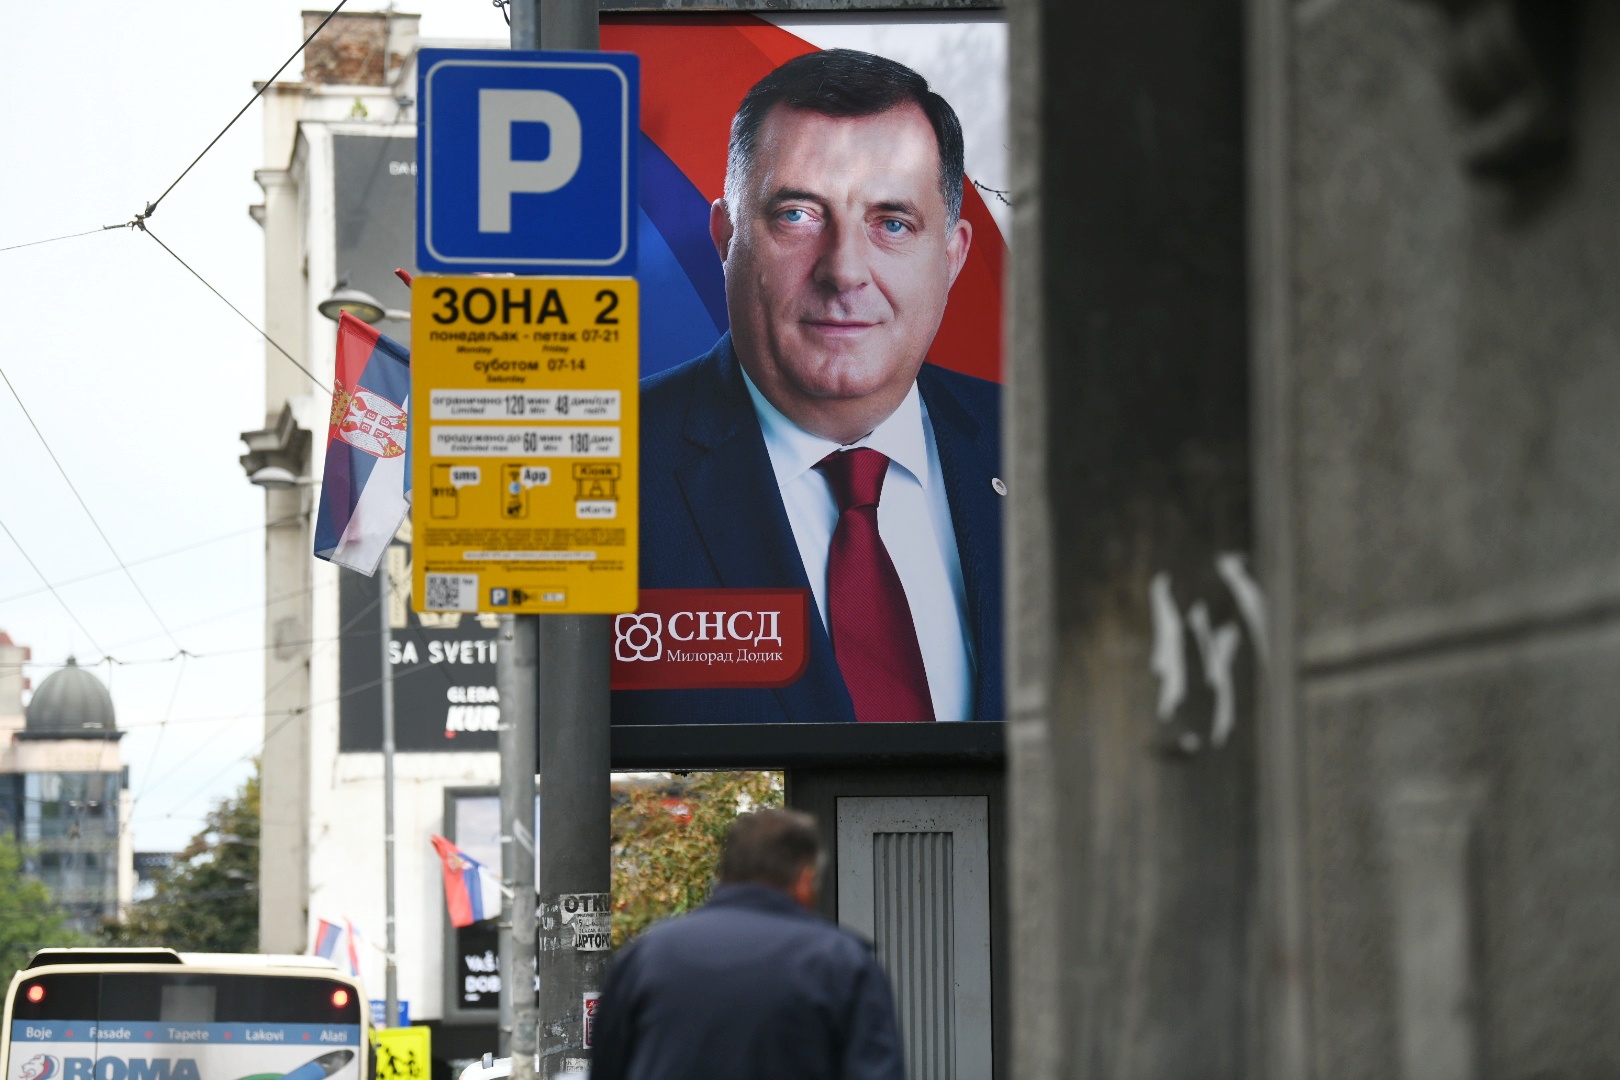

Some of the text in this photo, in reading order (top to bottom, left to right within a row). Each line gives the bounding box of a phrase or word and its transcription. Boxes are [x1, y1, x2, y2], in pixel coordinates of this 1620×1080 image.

[478, 88, 582, 233] P
[431, 287, 619, 325] ЗОНА 2
[429, 330, 519, 343] понедељак
[533, 330, 577, 342] петак
[582, 330, 619, 342] 07-21
[456, 345, 492, 355] Monday
[542, 345, 569, 354] Friday
[473, 358, 586, 373] суботом 07-14
[486, 375, 526, 384] Saturday
[504, 395, 525, 416] 120
[523, 432, 538, 452] 60
[453, 471, 478, 480] sms
[524, 470, 547, 482] App
[668, 611, 782, 647] СНСД
[388, 640, 418, 664] SA
[667, 649, 783, 665] Милорад Додик
[26, 1027, 347, 1042] Boje Fasade Tapete Lakovi Alati
[64, 1056, 202, 1080] ROMA
